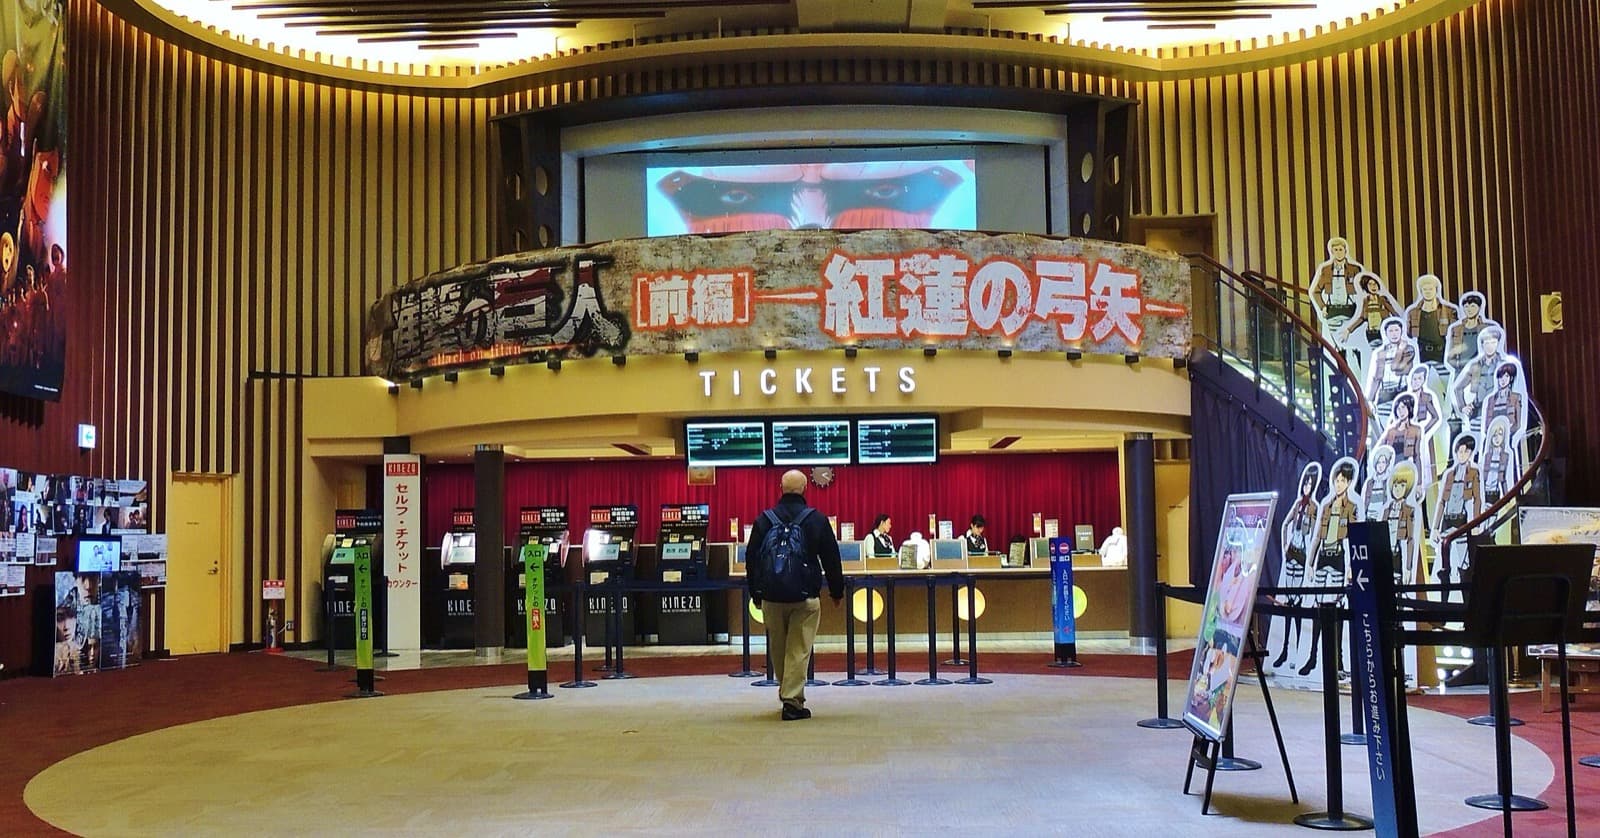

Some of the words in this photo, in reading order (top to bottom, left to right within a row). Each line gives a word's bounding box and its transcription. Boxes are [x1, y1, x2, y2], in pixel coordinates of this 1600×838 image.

[699, 366, 917, 396] TICKETS
[389, 464, 416, 475] KINEZO
[395, 482, 409, 573] セルフ・チケット
[356, 552, 369, 560] 入口
[528, 550, 541, 558] 入口
[1352, 544, 1368, 560] 入口
[517, 599, 556, 610] KZO
[662, 596, 701, 609] KINEZO
[1363, 613, 1385, 780] こちらからお進み下さい
